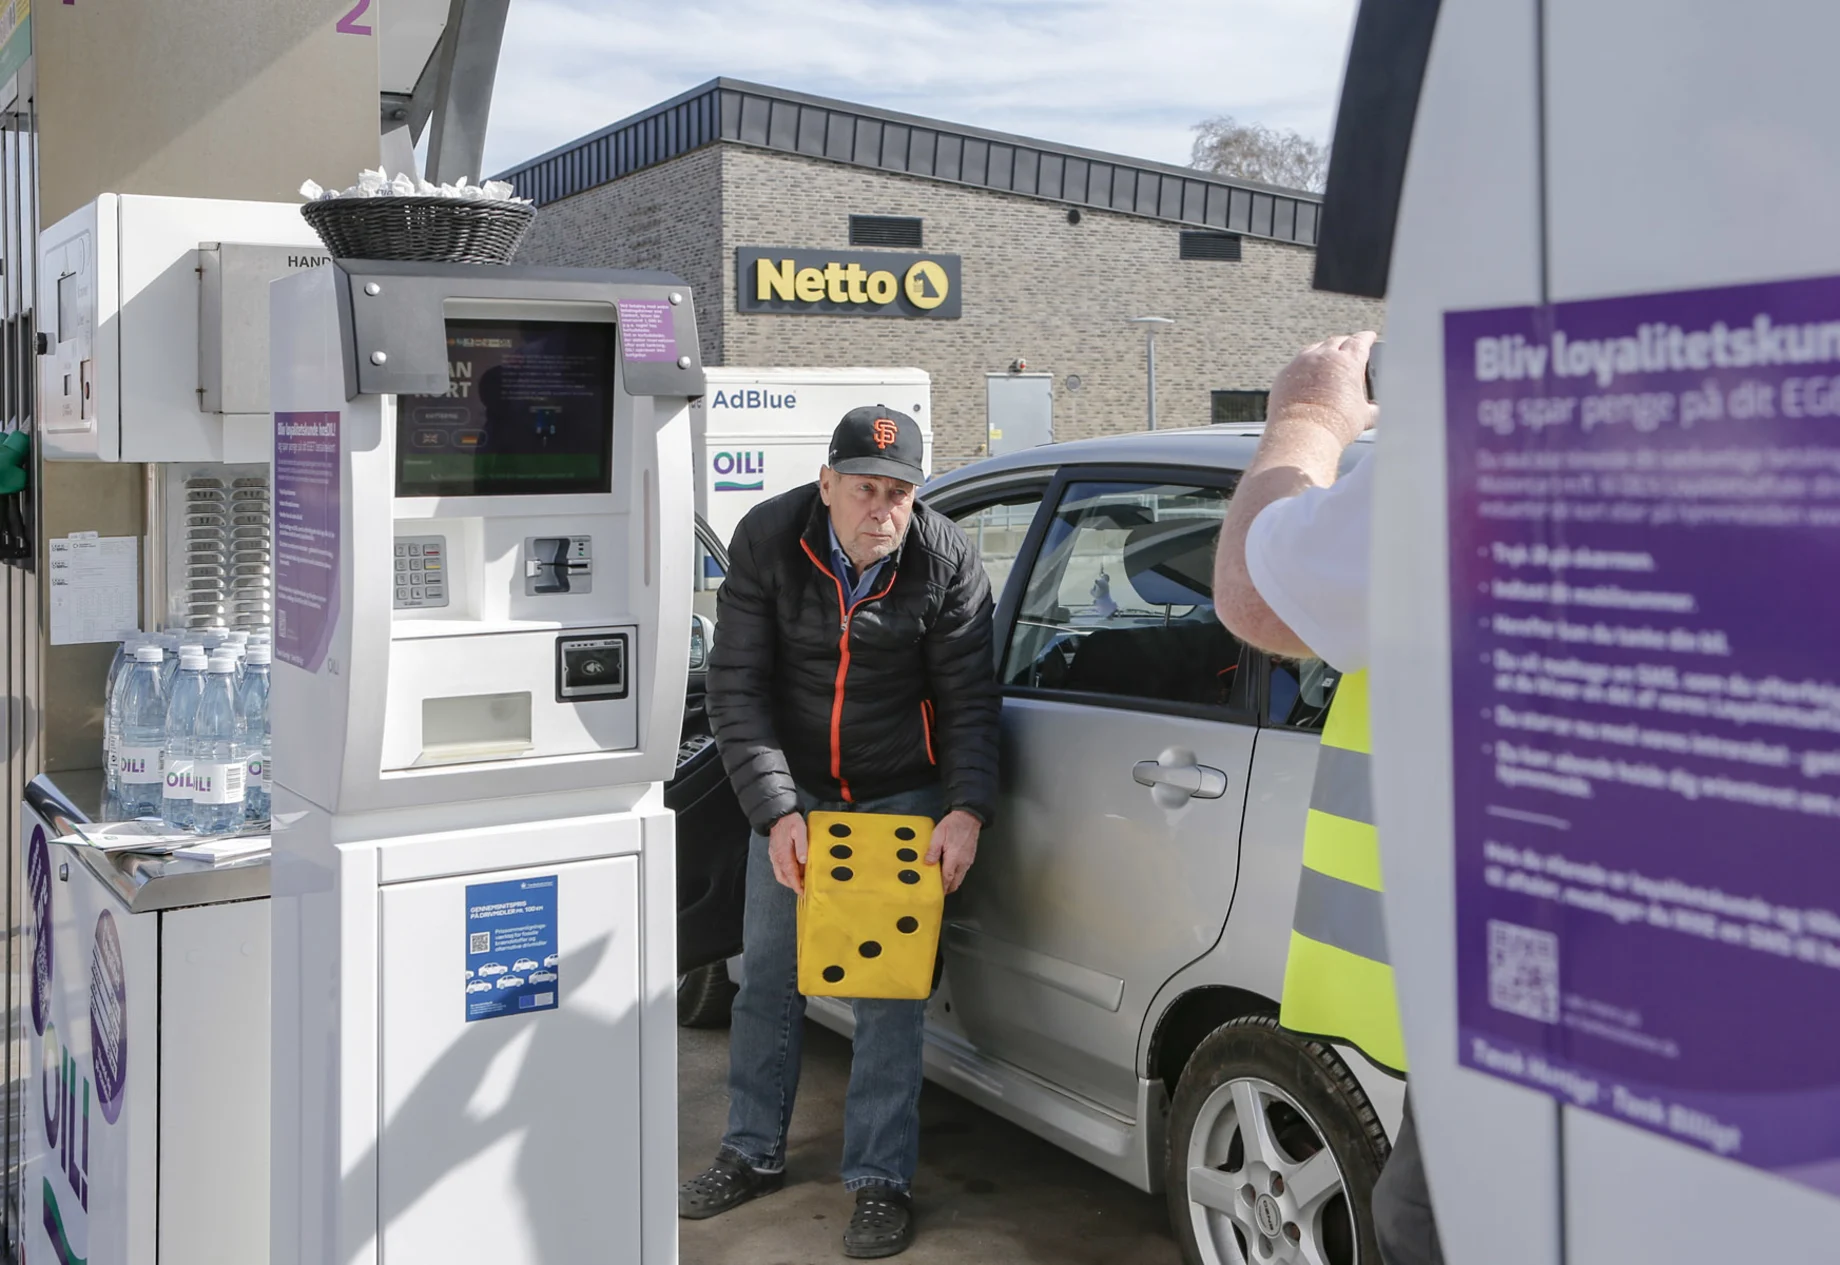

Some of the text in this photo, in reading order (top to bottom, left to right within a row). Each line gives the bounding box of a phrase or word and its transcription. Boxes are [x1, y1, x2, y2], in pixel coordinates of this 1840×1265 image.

[755, 258, 898, 305] Netto
[1475, 333, 1548, 381] Bliv
[712, 389, 797, 409] AdBlue
[1581, 391, 1676, 432] penge
[713, 450, 764, 475] OIL!
[193, 776, 212, 792] IL!
[42, 1022, 90, 1215] OIL!
